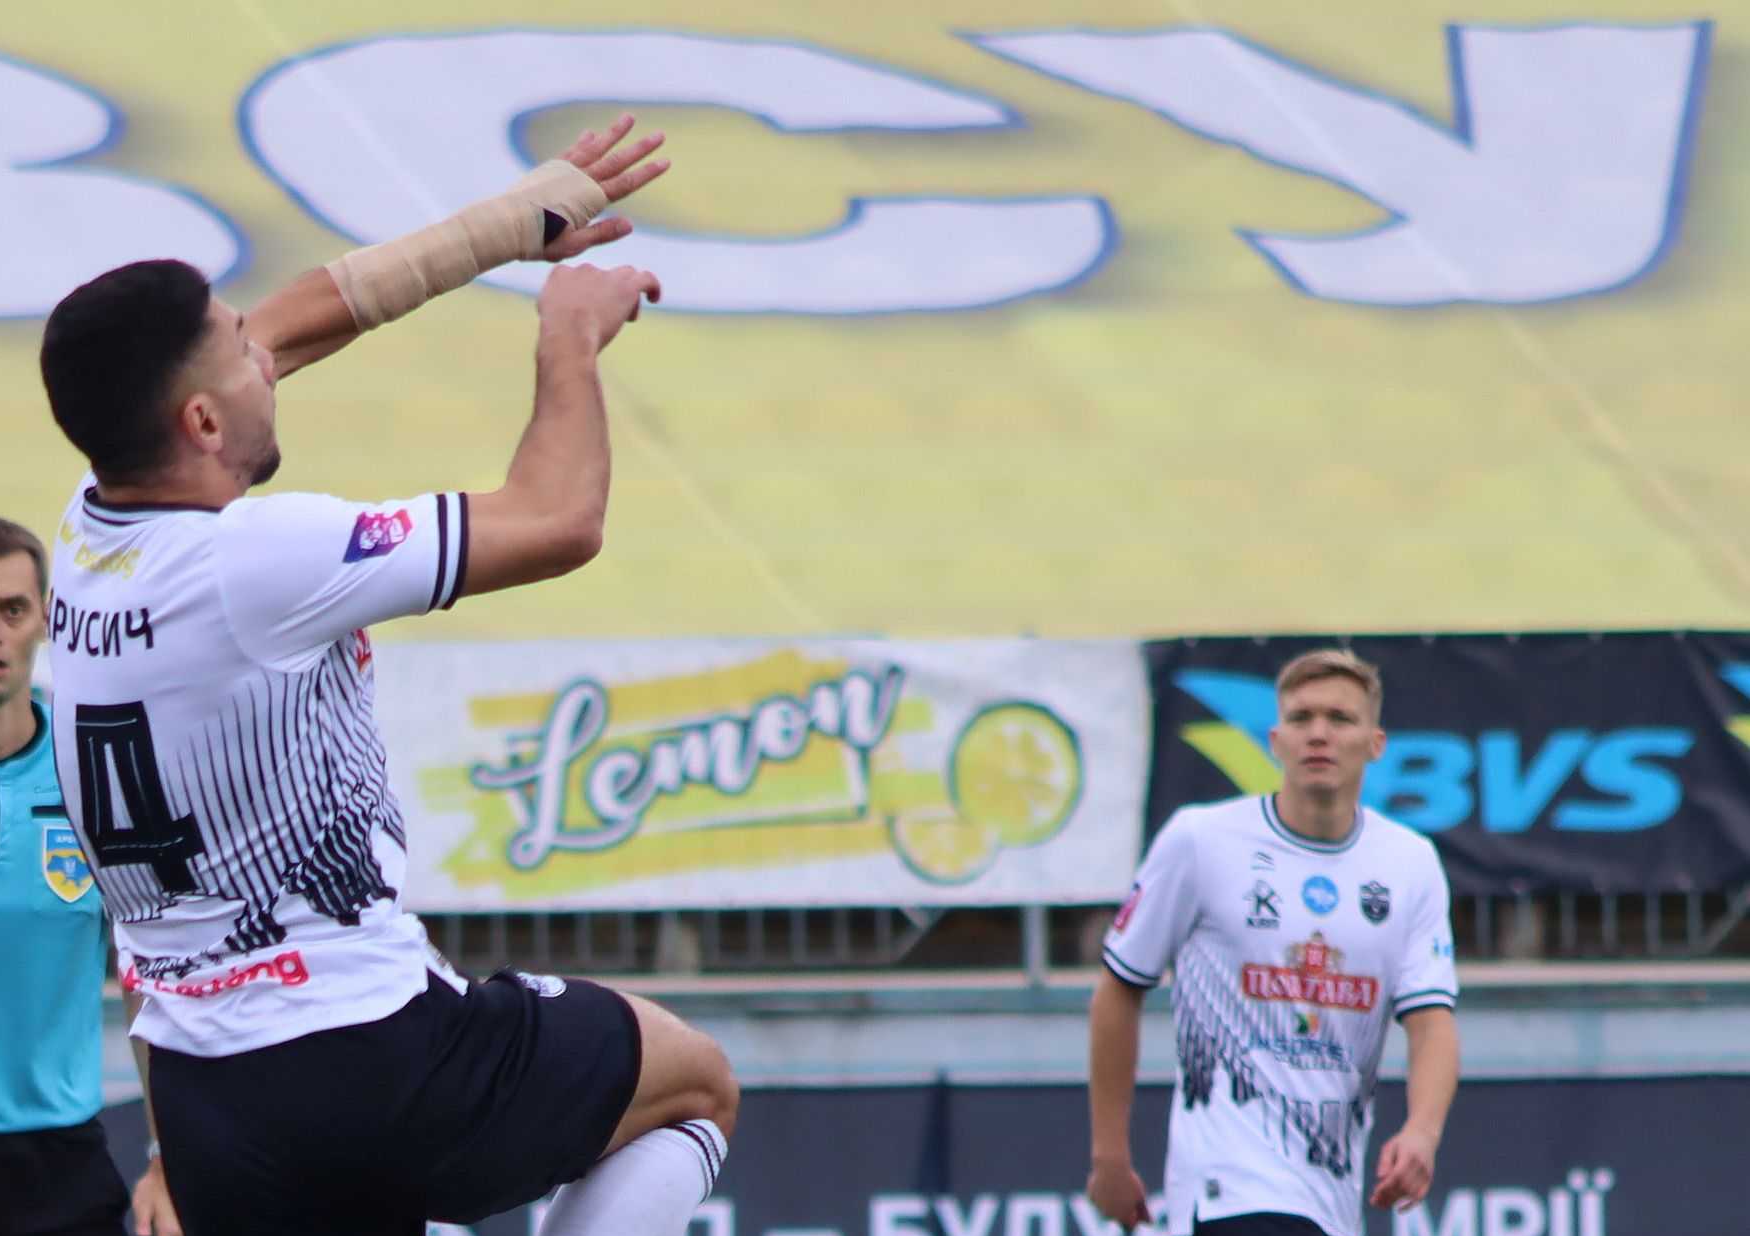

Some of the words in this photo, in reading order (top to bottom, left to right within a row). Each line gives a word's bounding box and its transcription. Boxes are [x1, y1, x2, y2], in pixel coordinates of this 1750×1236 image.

[47, 588, 154, 657] РУСИЧ
[472, 664, 905, 871] Lemon
[1362, 728, 1696, 833] BVS
